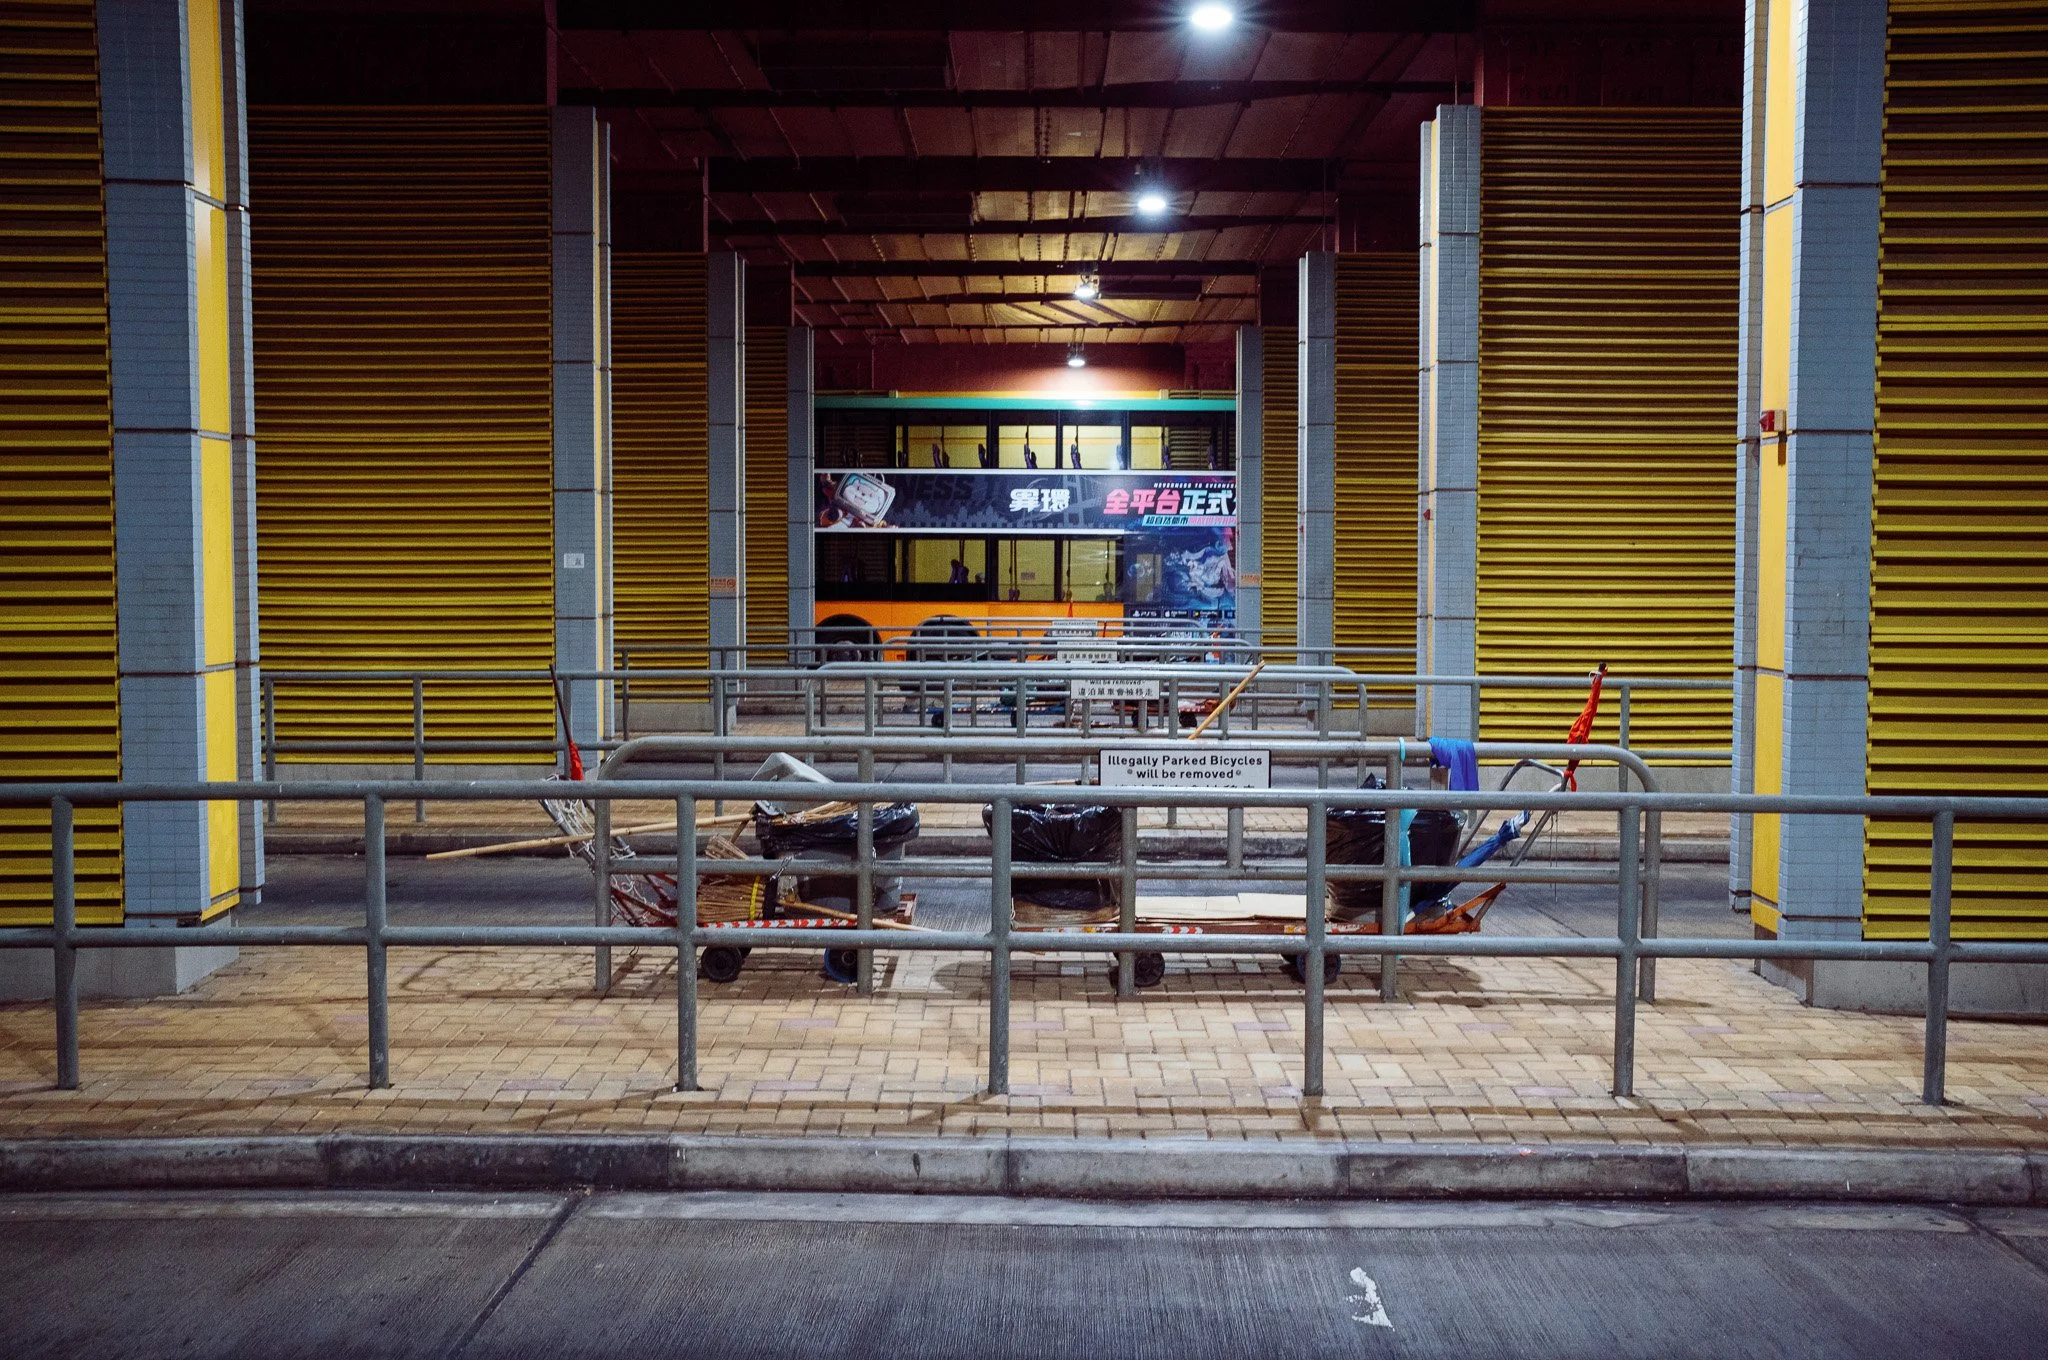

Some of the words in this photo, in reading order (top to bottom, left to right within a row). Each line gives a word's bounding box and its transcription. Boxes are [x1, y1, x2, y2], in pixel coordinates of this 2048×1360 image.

[1103, 488, 1236, 515] 全平台正式
[1108, 755, 1158, 768] Illegally
[1162, 755, 1206, 765] Parked
[1210, 755, 1262, 768] Bicycles
[1136, 768, 1158, 778] will
[1162, 768, 1176, 778] be
[1180, 768, 1234, 779] removed
